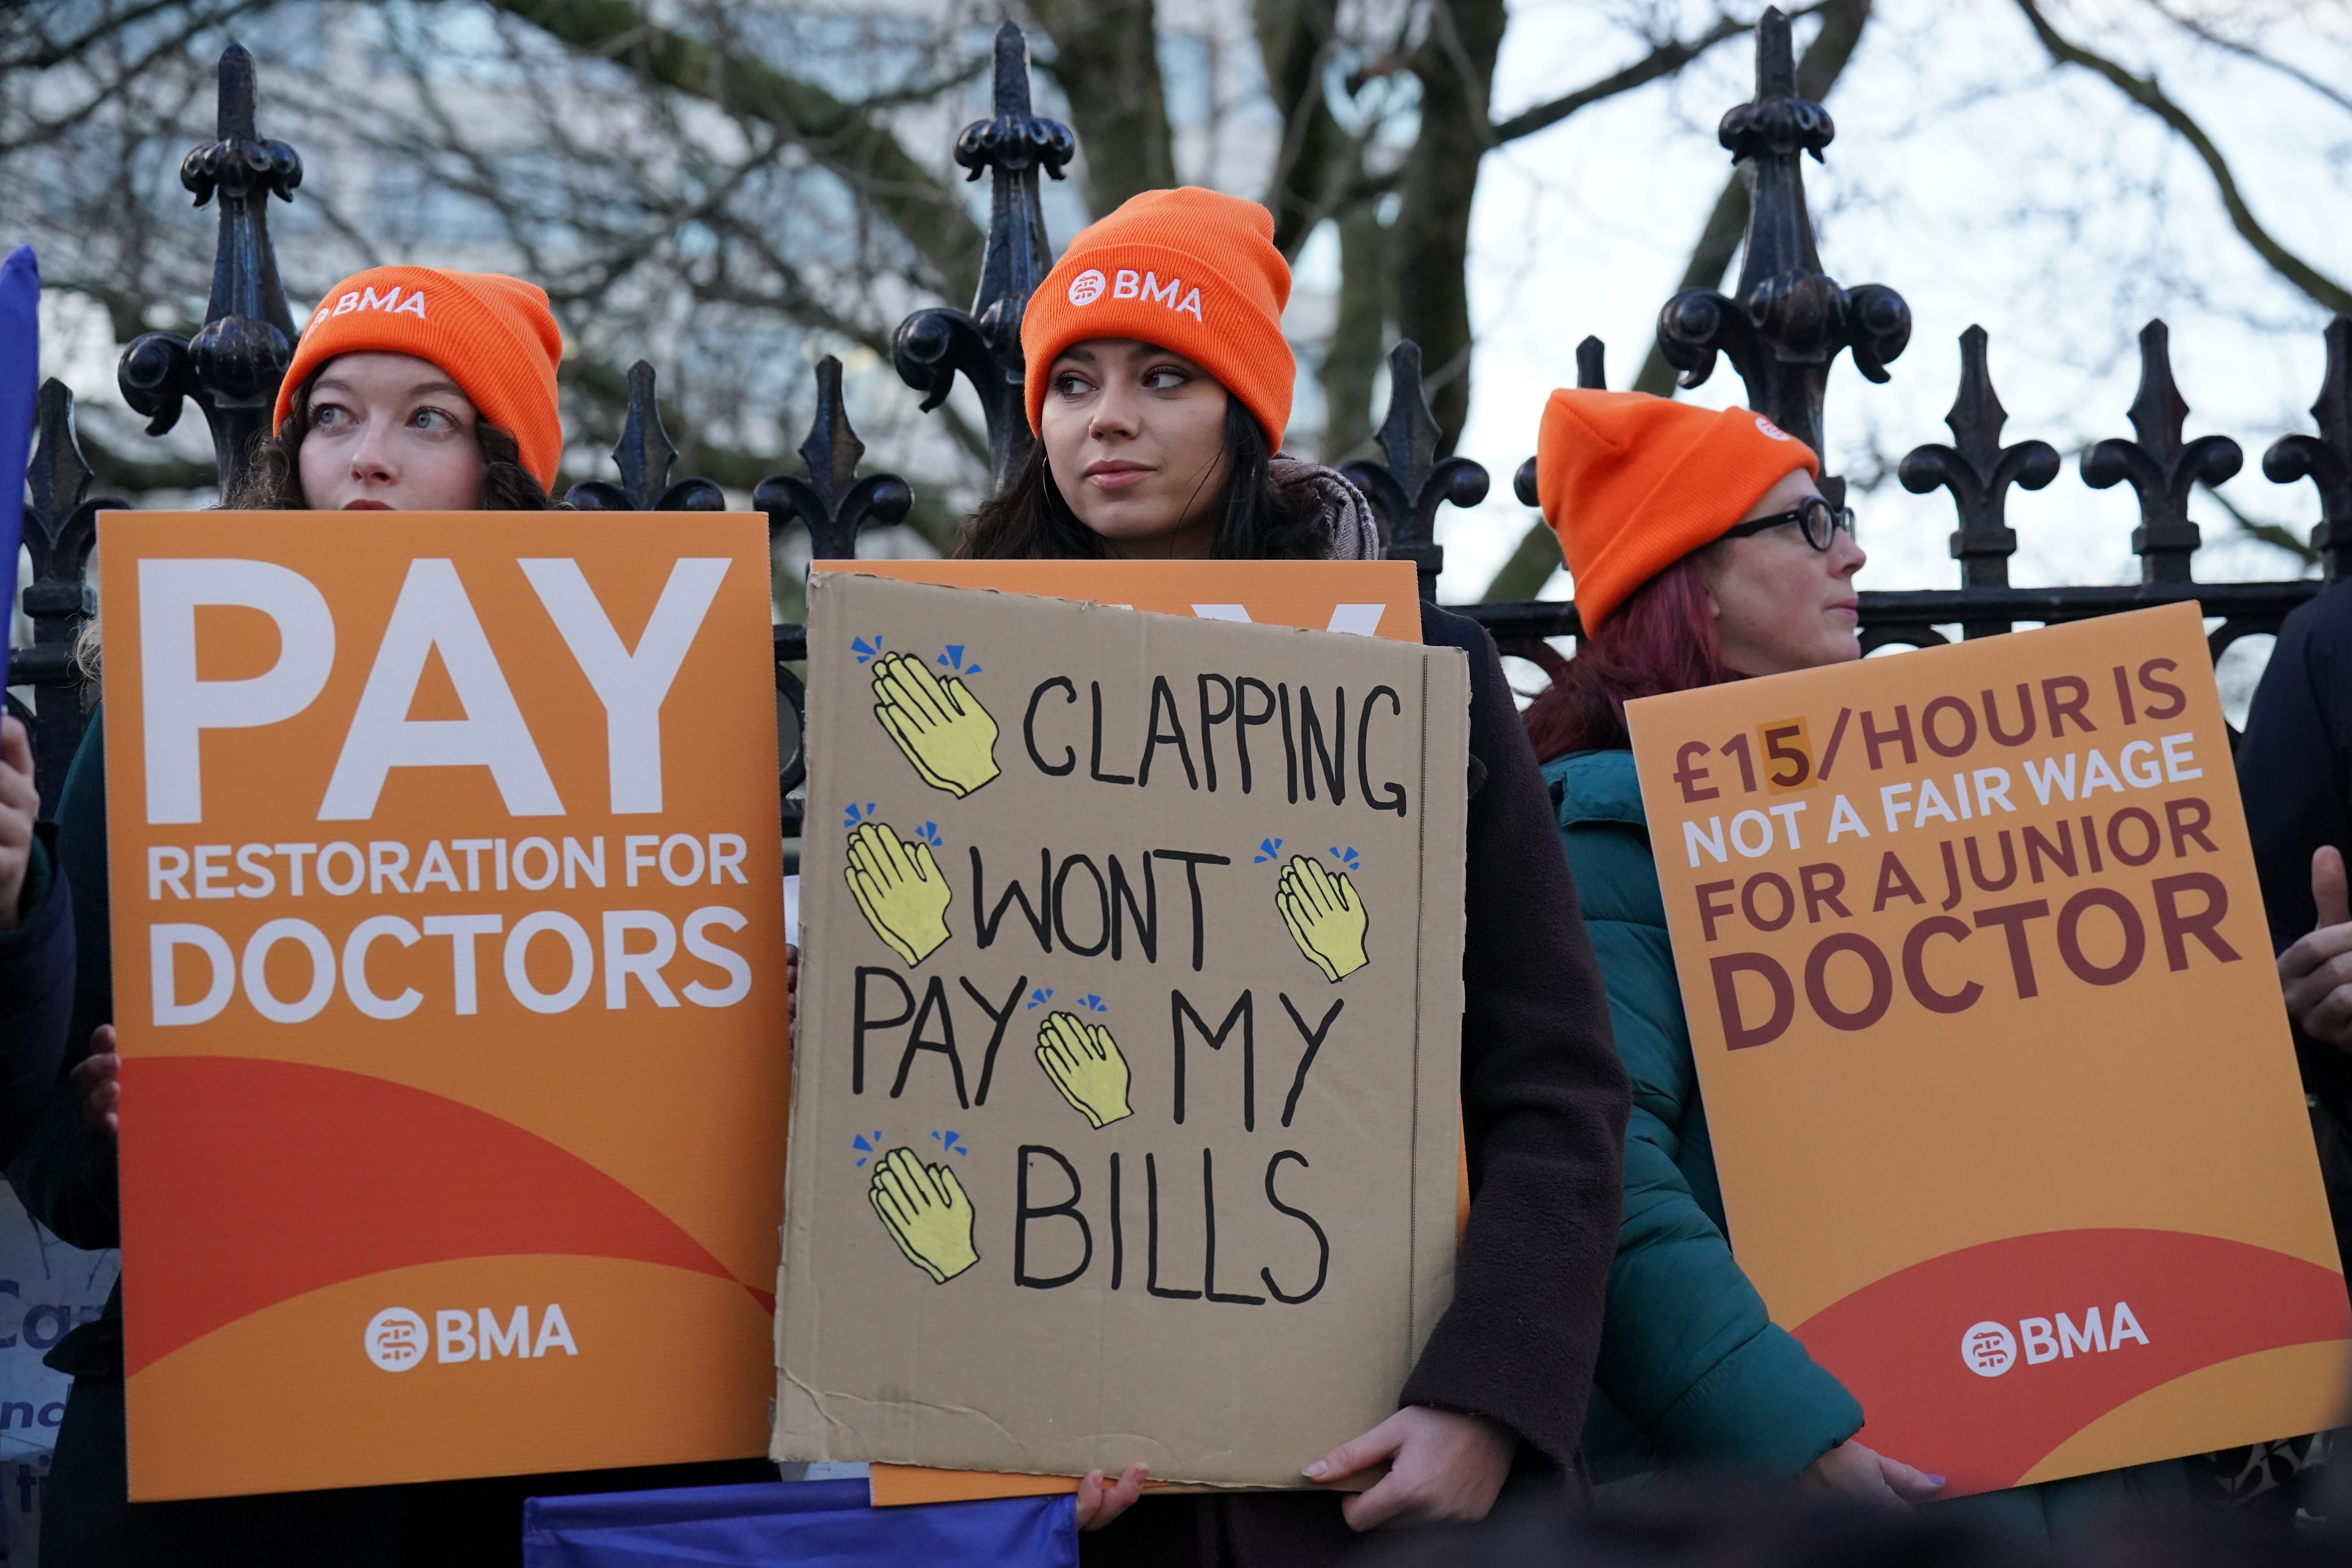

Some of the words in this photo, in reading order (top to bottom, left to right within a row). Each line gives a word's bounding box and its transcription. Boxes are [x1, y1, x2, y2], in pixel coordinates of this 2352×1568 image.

[331, 286, 426, 319] BMA
[1112, 269, 1202, 322] BMA
[138, 557, 733, 824] PAY
[1023, 673, 1407, 817] CLAPPING
[1673, 676, 2098, 804] £15/HOUR
[2113, 658, 2186, 726] IS
[148, 836, 606, 900] RESTORATION
[625, 833, 748, 887] FOR
[1682, 801, 1806, 867] NOT
[1827, 794, 1870, 843] A
[1880, 767, 2017, 833] FAIR
[2023, 732, 2203, 805] WAGE
[969, 846, 1231, 972] WONT
[1695, 863, 1853, 942] FOR
[1873, 851, 1926, 913] A
[1940, 798, 2219, 912] JUNIOR
[150, 906, 751, 1026] DOCTORS
[1710, 872, 2242, 1052] DOCTOR
[852, 965, 1028, 1110] PAY
[1171, 989, 1345, 1133] MY
[1013, 1144, 1330, 1306] BILLS
[436, 1303, 579, 1364] BMA
[2019, 1301, 2150, 1365] BMA
